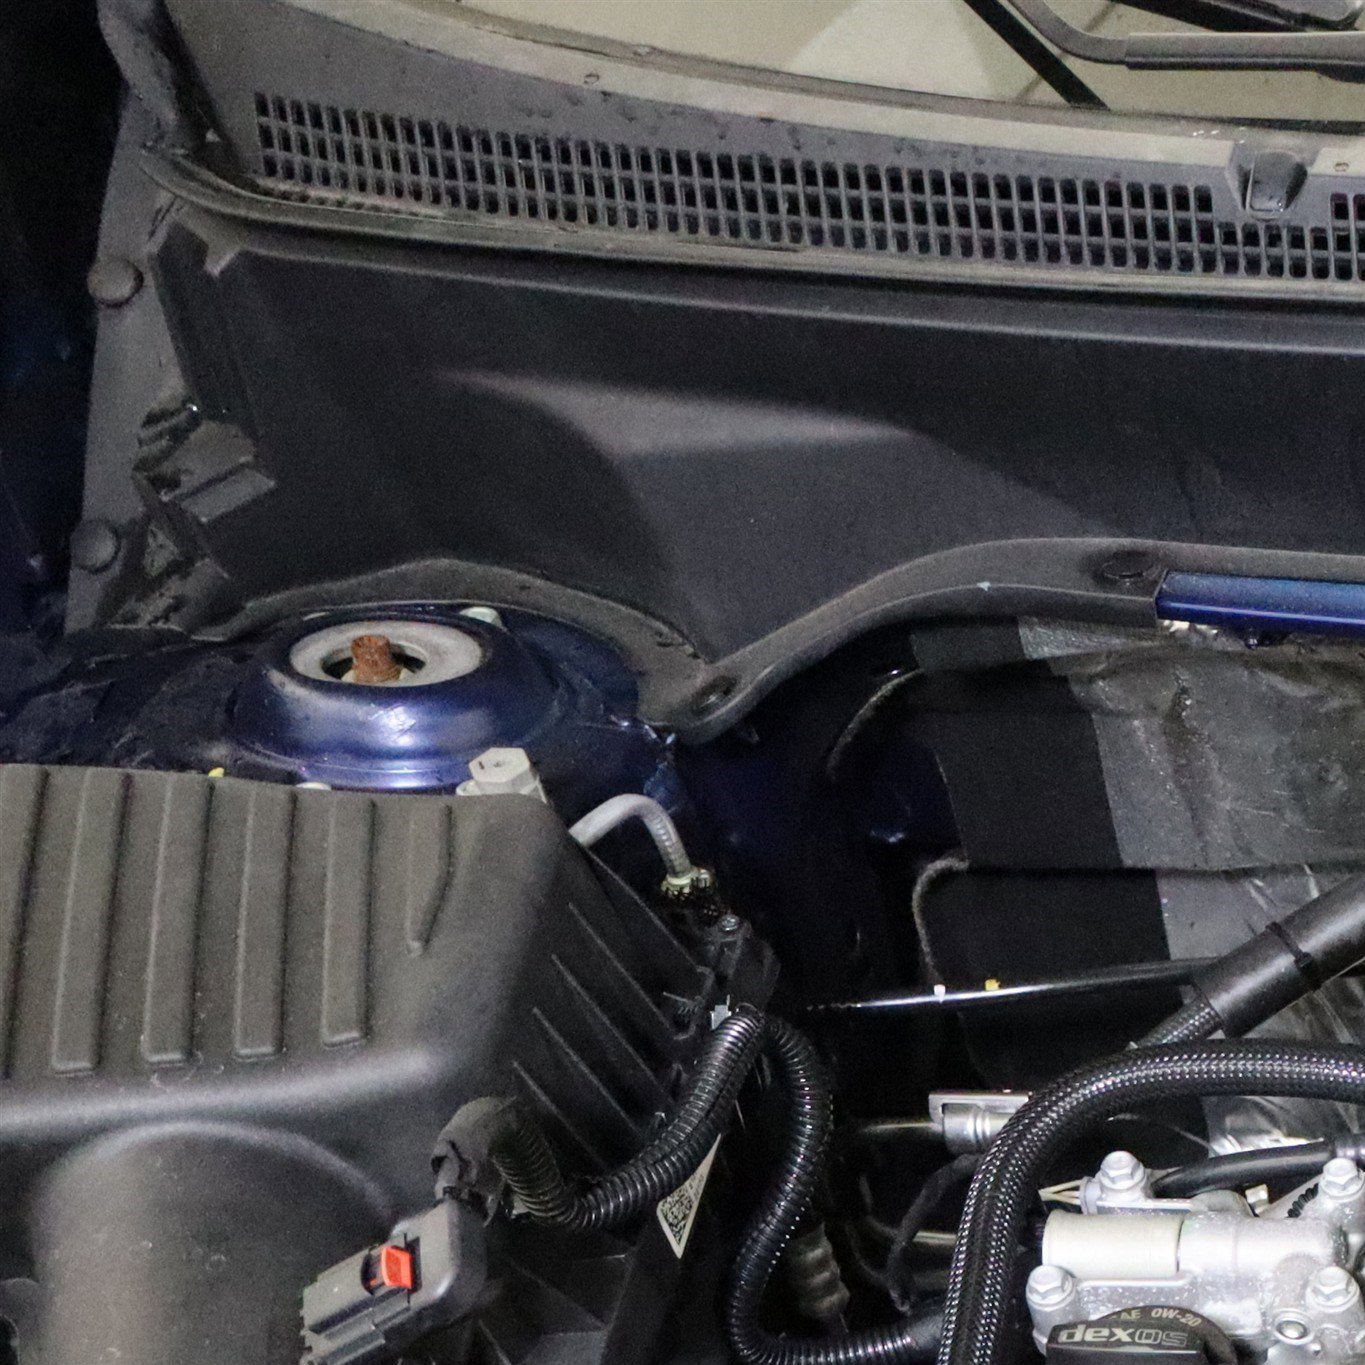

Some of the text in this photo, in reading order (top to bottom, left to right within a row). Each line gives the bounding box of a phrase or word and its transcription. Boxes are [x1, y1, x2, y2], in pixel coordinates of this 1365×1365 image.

[1110, 1307, 1203, 1328] AE 0W-20
[1057, 1323, 1188, 1348] dexos
